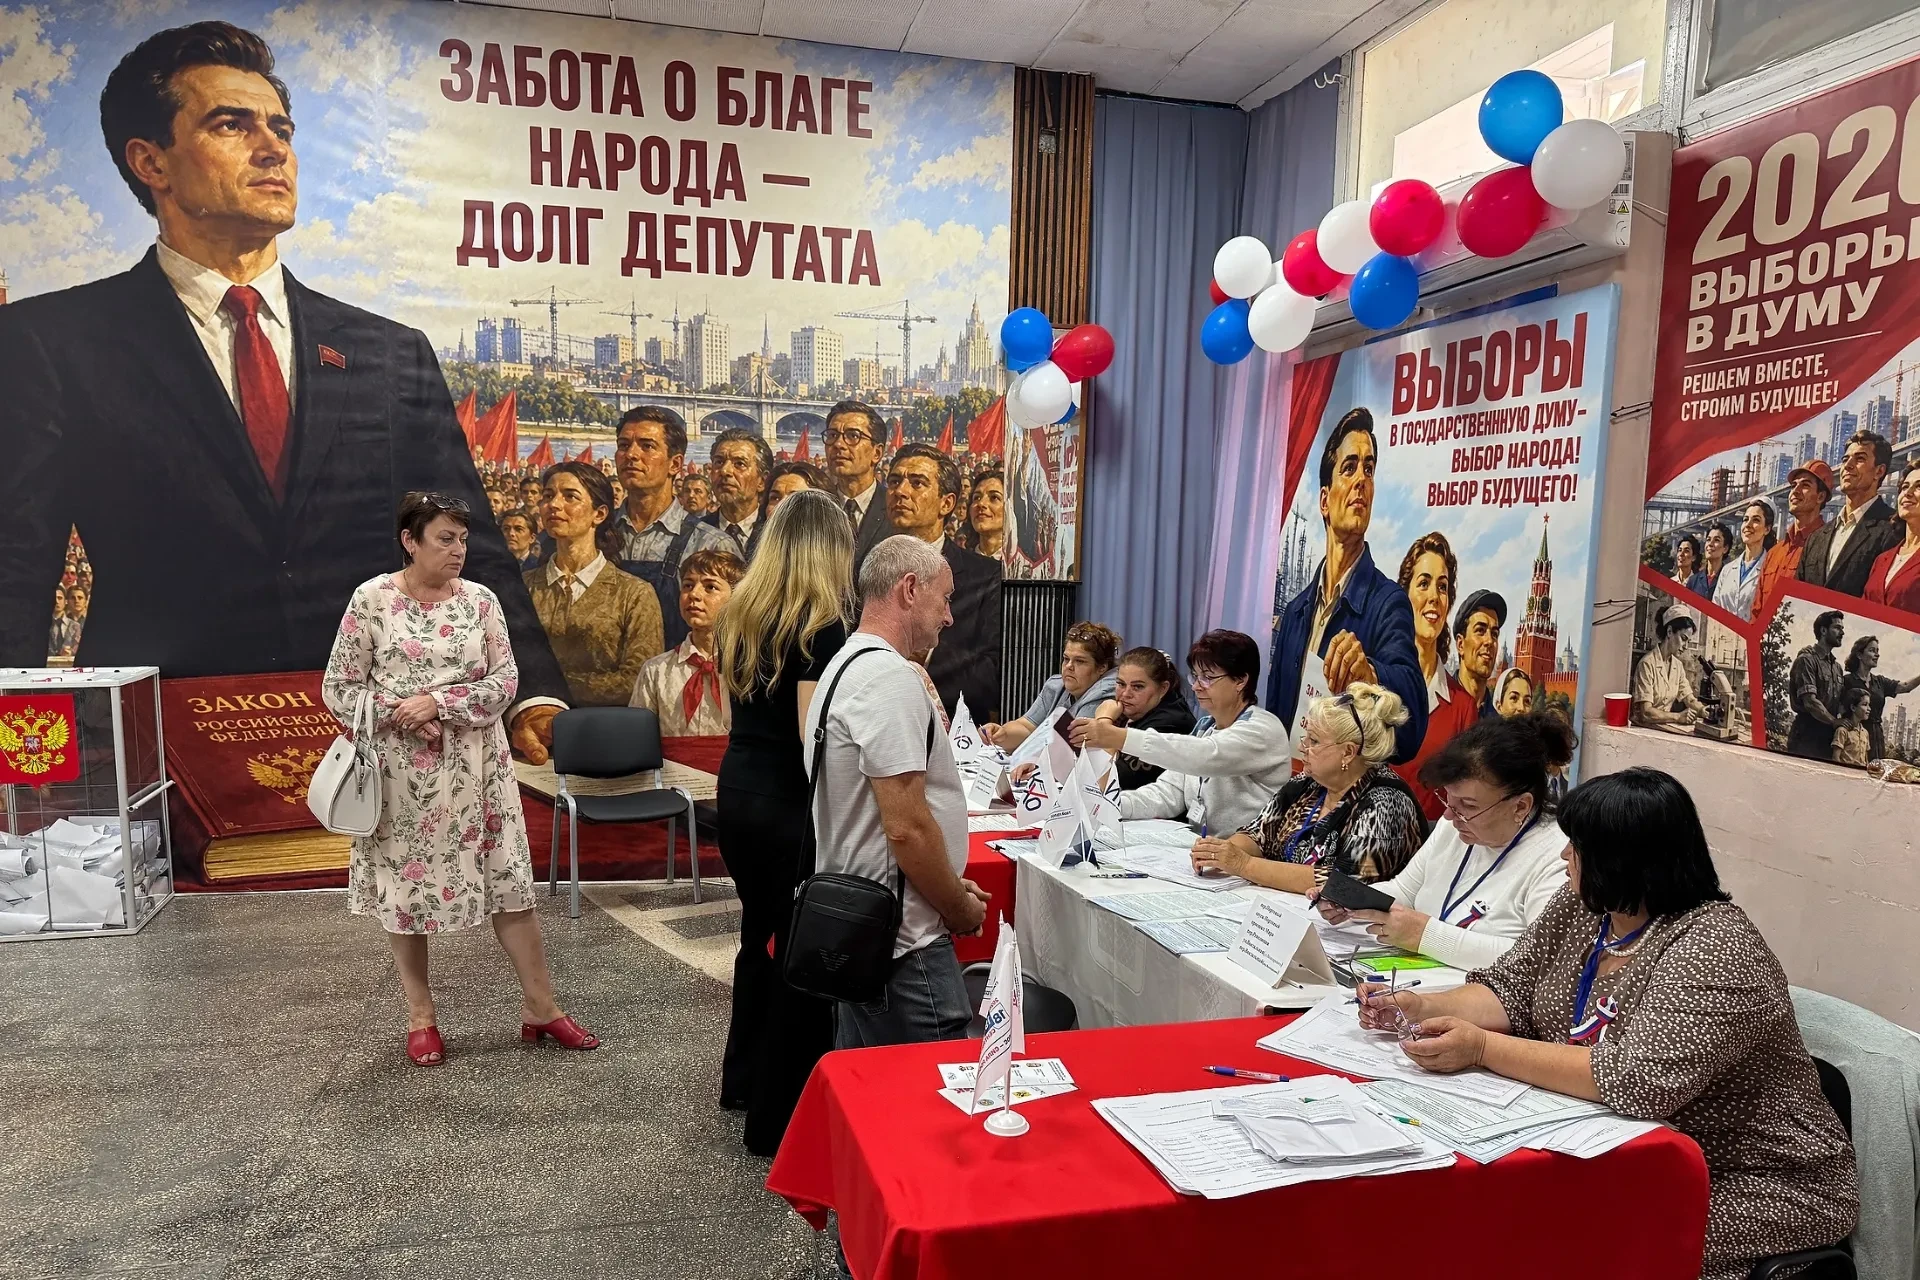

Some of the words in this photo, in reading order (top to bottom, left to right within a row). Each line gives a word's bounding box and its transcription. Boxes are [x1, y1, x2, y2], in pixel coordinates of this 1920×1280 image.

[439, 38, 644, 118] ЗАБОТА
[663, 60, 697, 122] О
[717, 66, 873, 139] БЛАГЕ
[529, 126, 746, 208] НАРОДА
[456, 200, 604, 268] ДОЛГ
[621, 211, 881, 286] ДЕПУТАТА
[1685, 315, 1714, 353] В
[1724, 275, 1884, 351] ДУМУ
[1392, 312, 1588, 416] ВЫБОРЫ
[1682, 366, 1750, 396] РЕШАЕМ
[1755, 353, 1829, 385] ВМЕСТЕ,
[1681, 394, 1744, 422] СТРОИМ
[1750, 380, 1839, 413] БУДУЩЕЕ!
[1390, 424, 1398, 447] В
[1451, 444, 1504, 473] ВЫБОР
[1507, 436, 1581, 470] НАРОДА!
[1427, 480, 1478, 507] ВЫБОР
[1481, 473, 1578, 508] БУДУЩЕГО!
[187, 691, 316, 713] ЗАКОН
[193, 711, 336, 731] РОССИЙСКОЙ
[209, 724, 342, 743] ФЕДЕРАЦИИ
